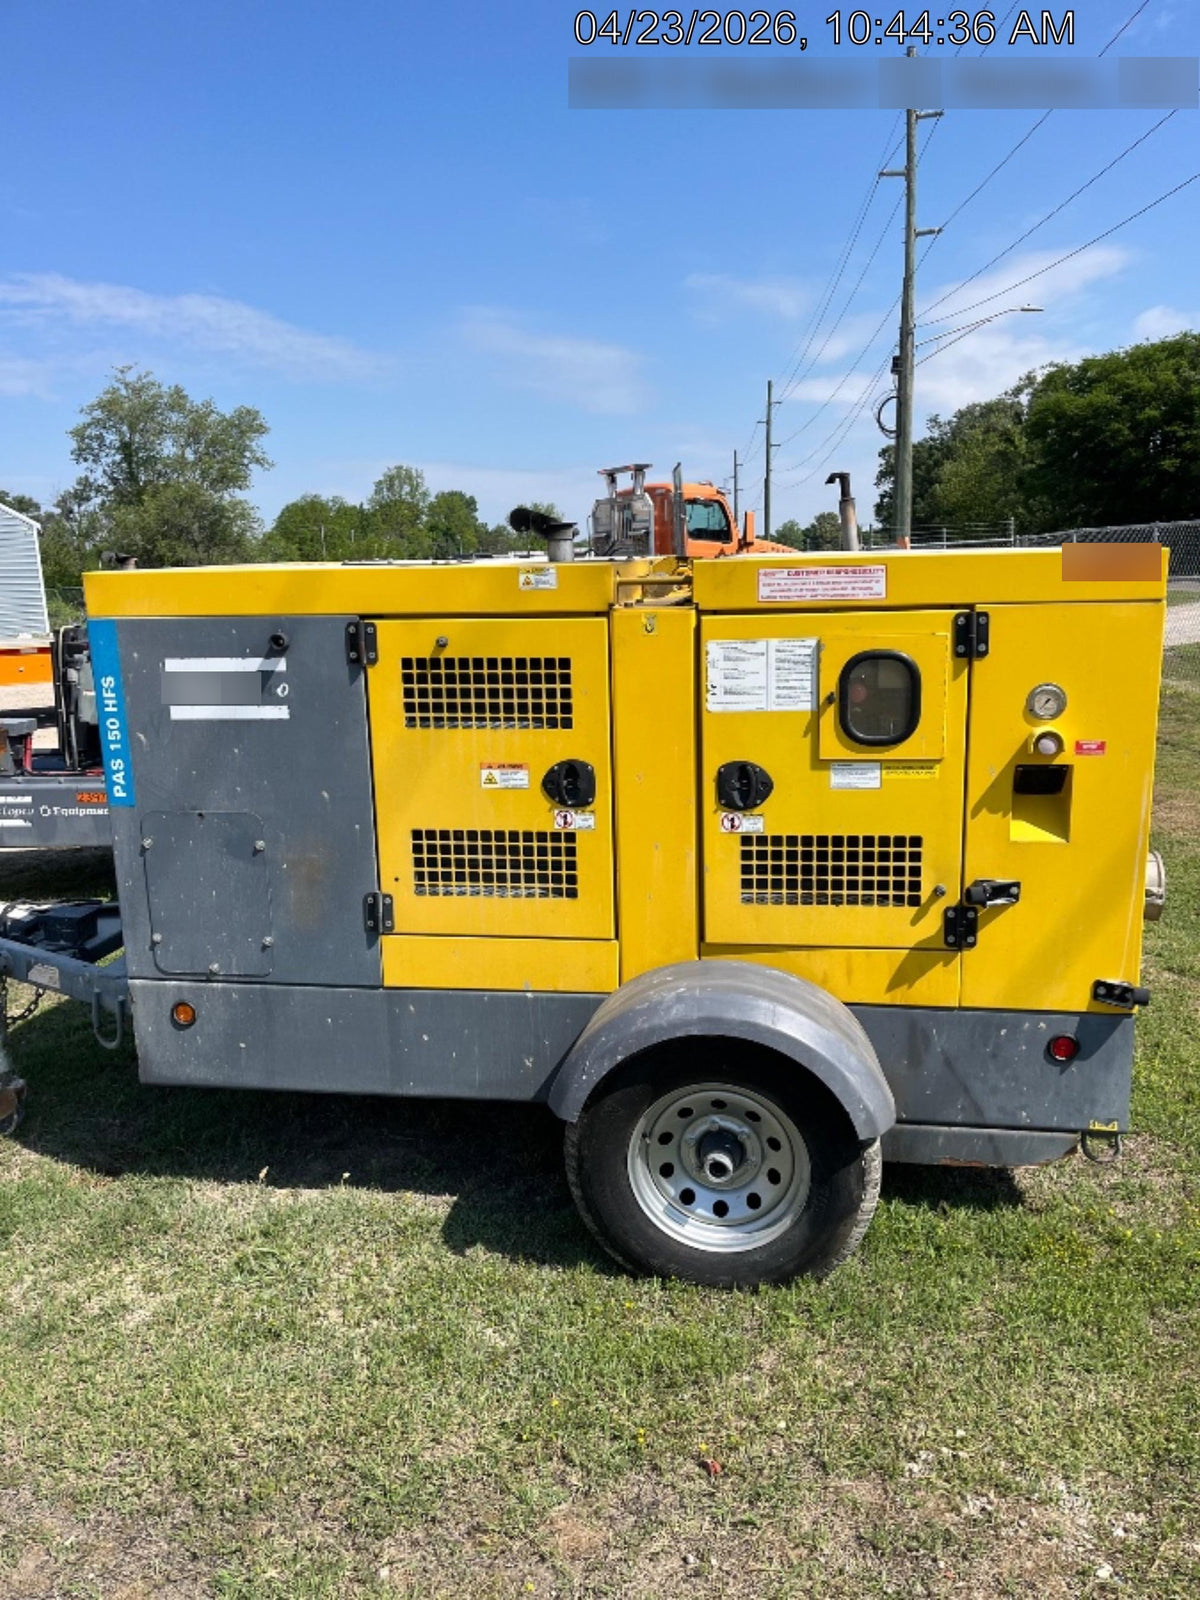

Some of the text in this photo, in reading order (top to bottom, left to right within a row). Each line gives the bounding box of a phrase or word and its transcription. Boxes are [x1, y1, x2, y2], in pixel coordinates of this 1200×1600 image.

[100, 675, 127, 798] PAS 150 HFS
